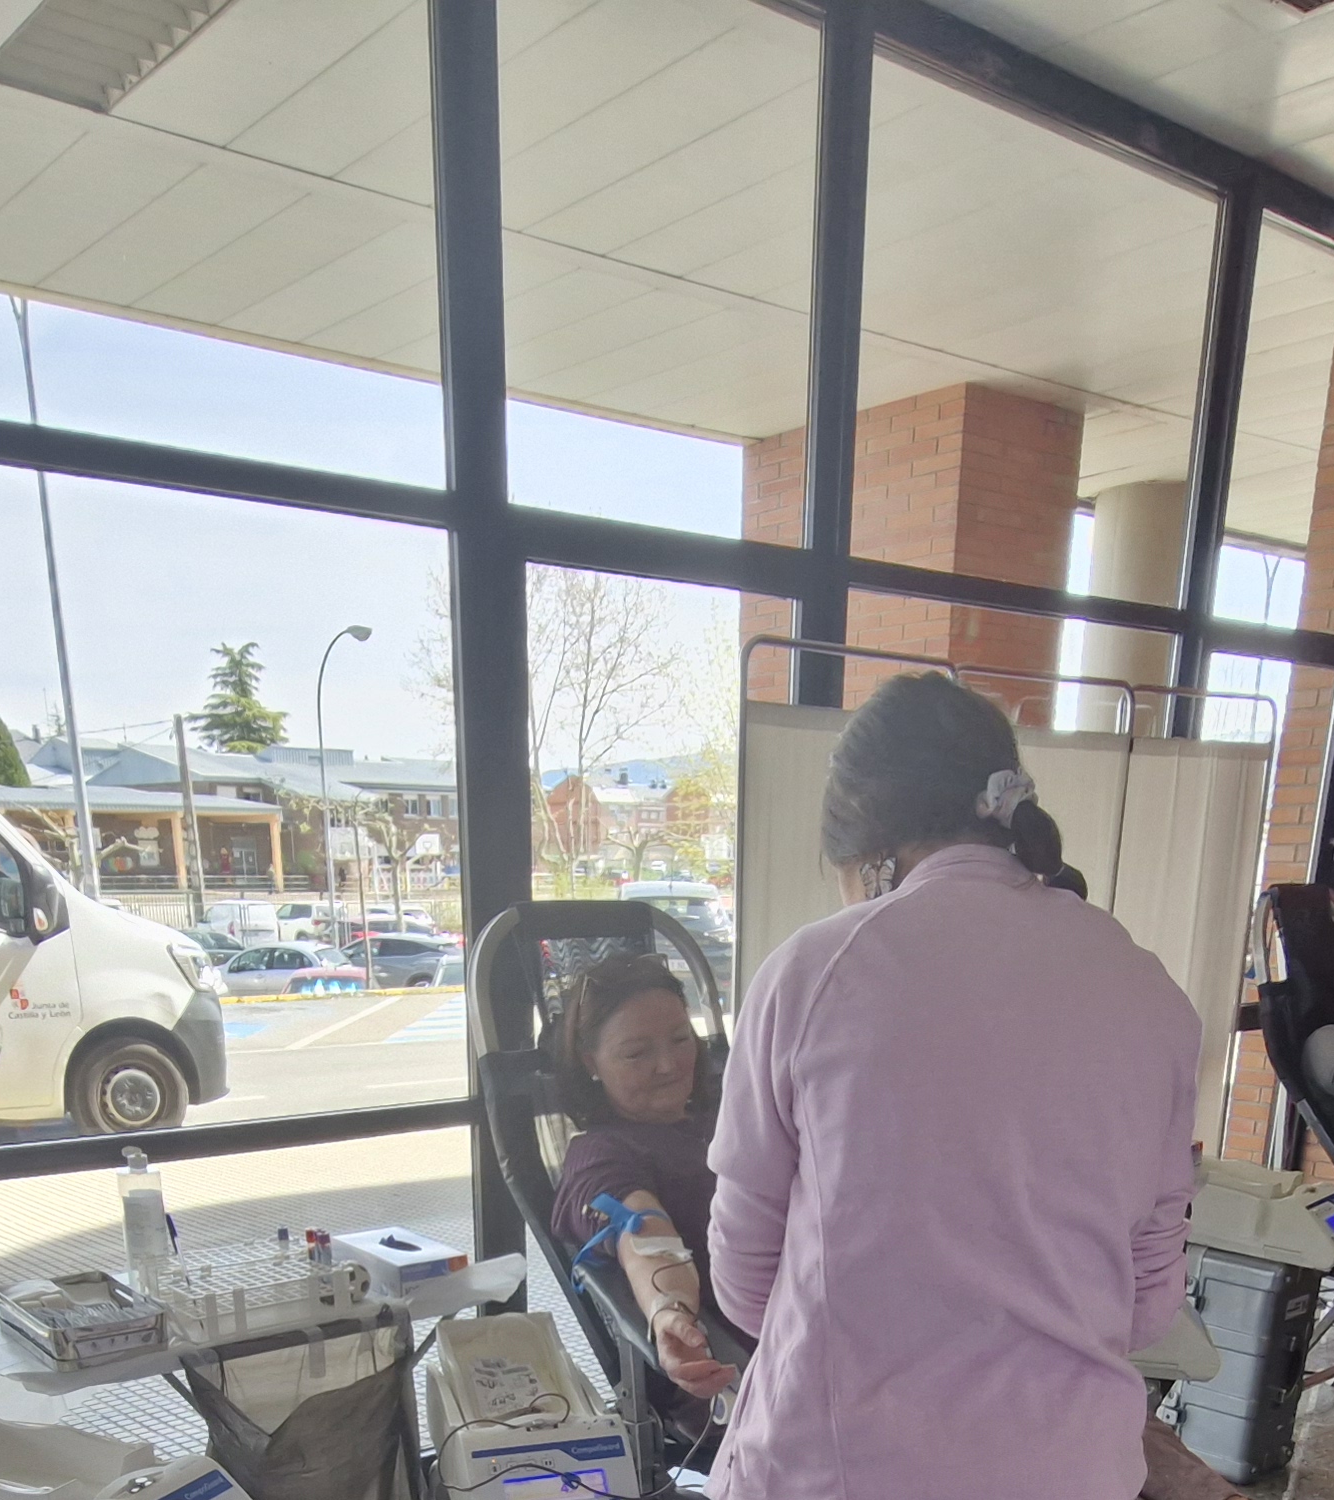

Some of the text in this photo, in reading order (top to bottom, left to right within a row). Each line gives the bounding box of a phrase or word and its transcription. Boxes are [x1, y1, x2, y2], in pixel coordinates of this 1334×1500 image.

[31, 1001, 57, 1010] Junta
[8, 1010, 40, 1020] Castilla
[52, 1009, 71, 1018] León
